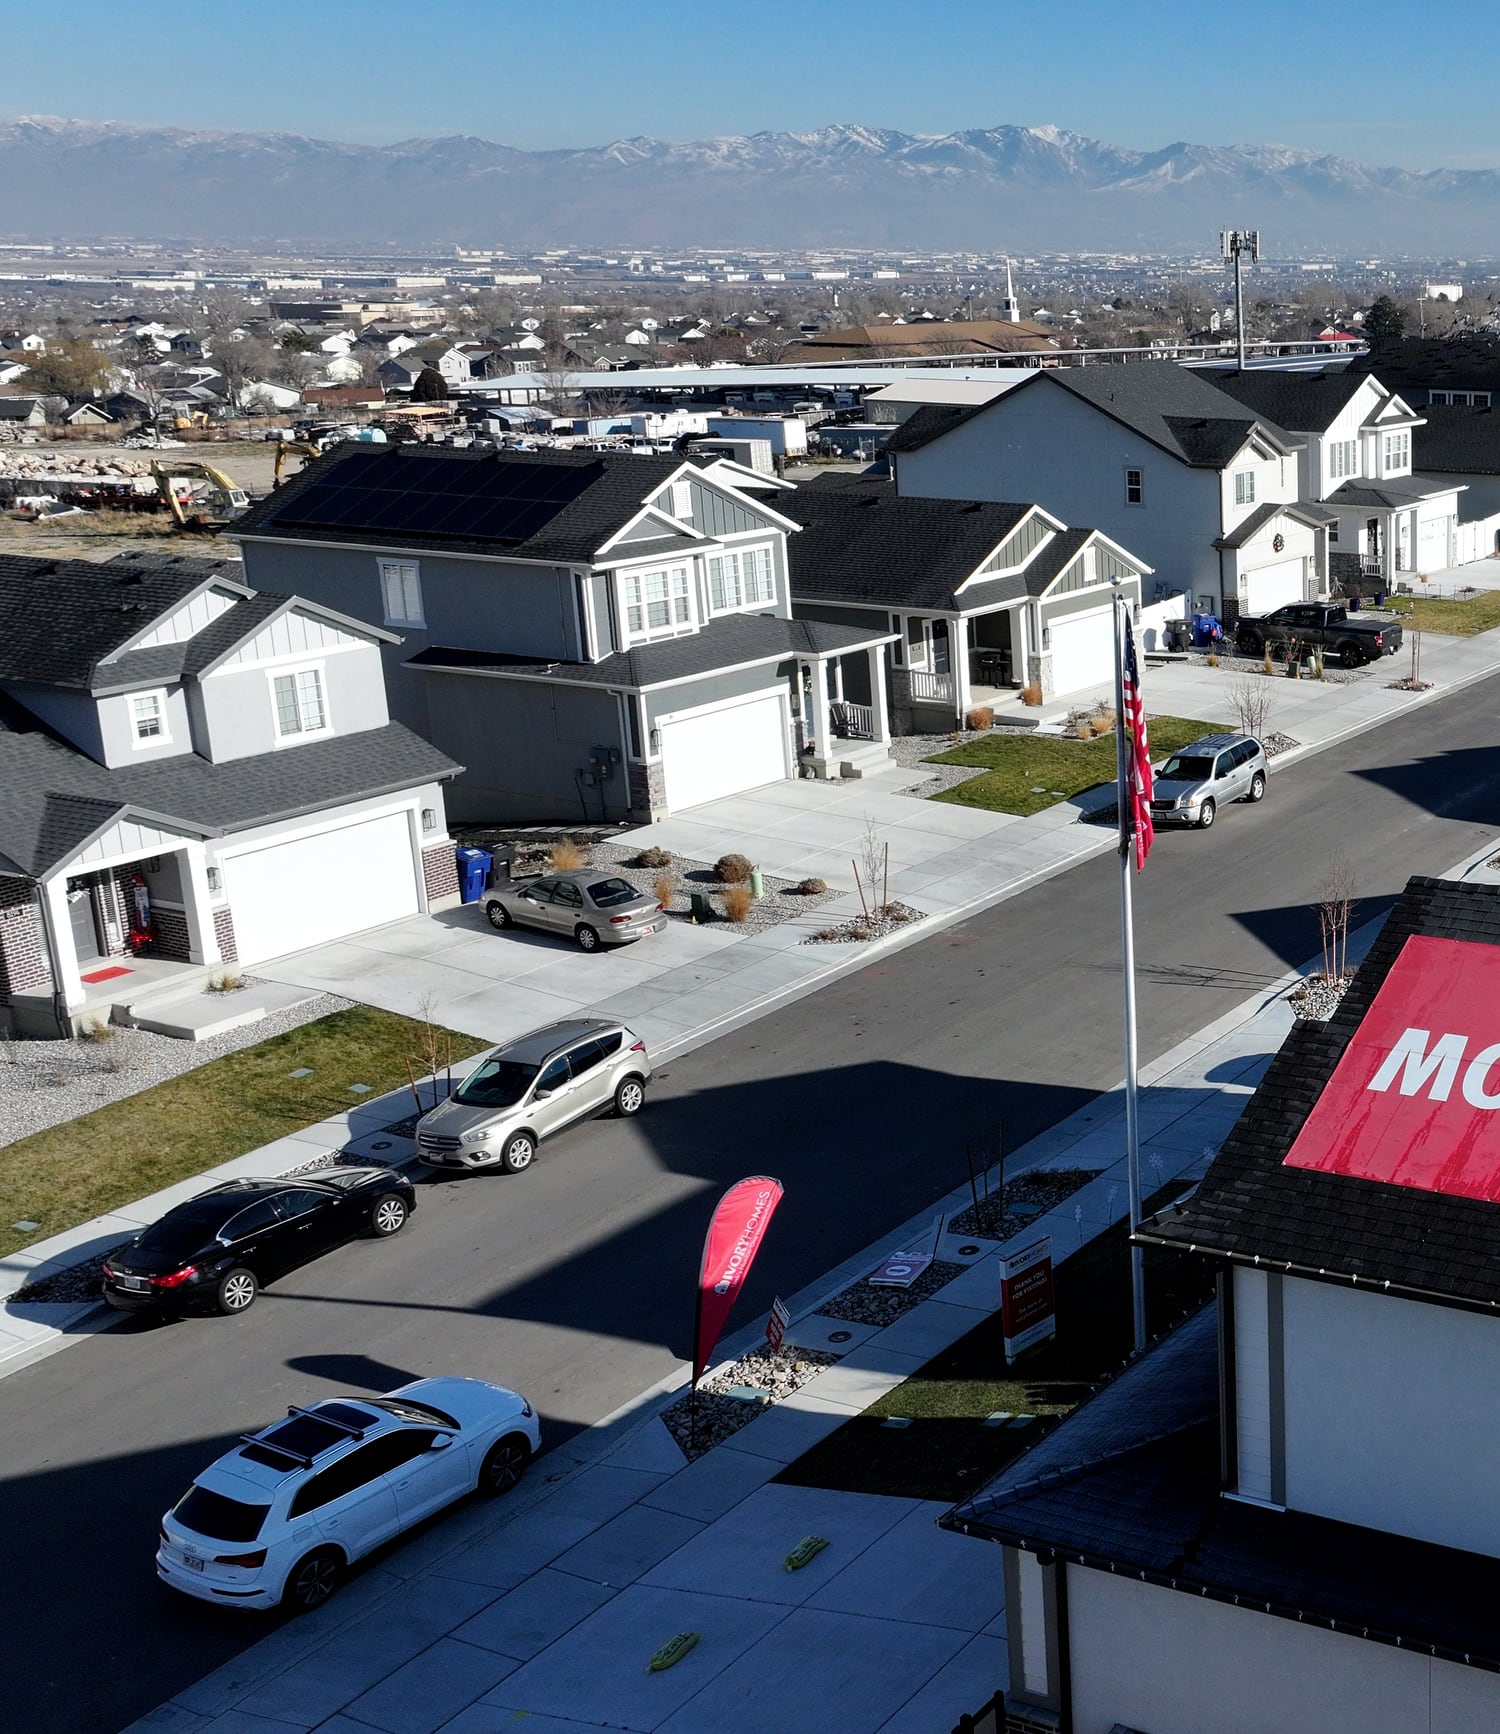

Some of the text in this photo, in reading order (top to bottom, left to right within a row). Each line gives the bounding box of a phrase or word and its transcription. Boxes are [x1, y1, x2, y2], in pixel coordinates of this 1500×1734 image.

[722, 1191, 771, 1284] IVORYHOMES
[1033, 1270, 1045, 1281] YOU
[1012, 1290, 1023, 1301] FOR
